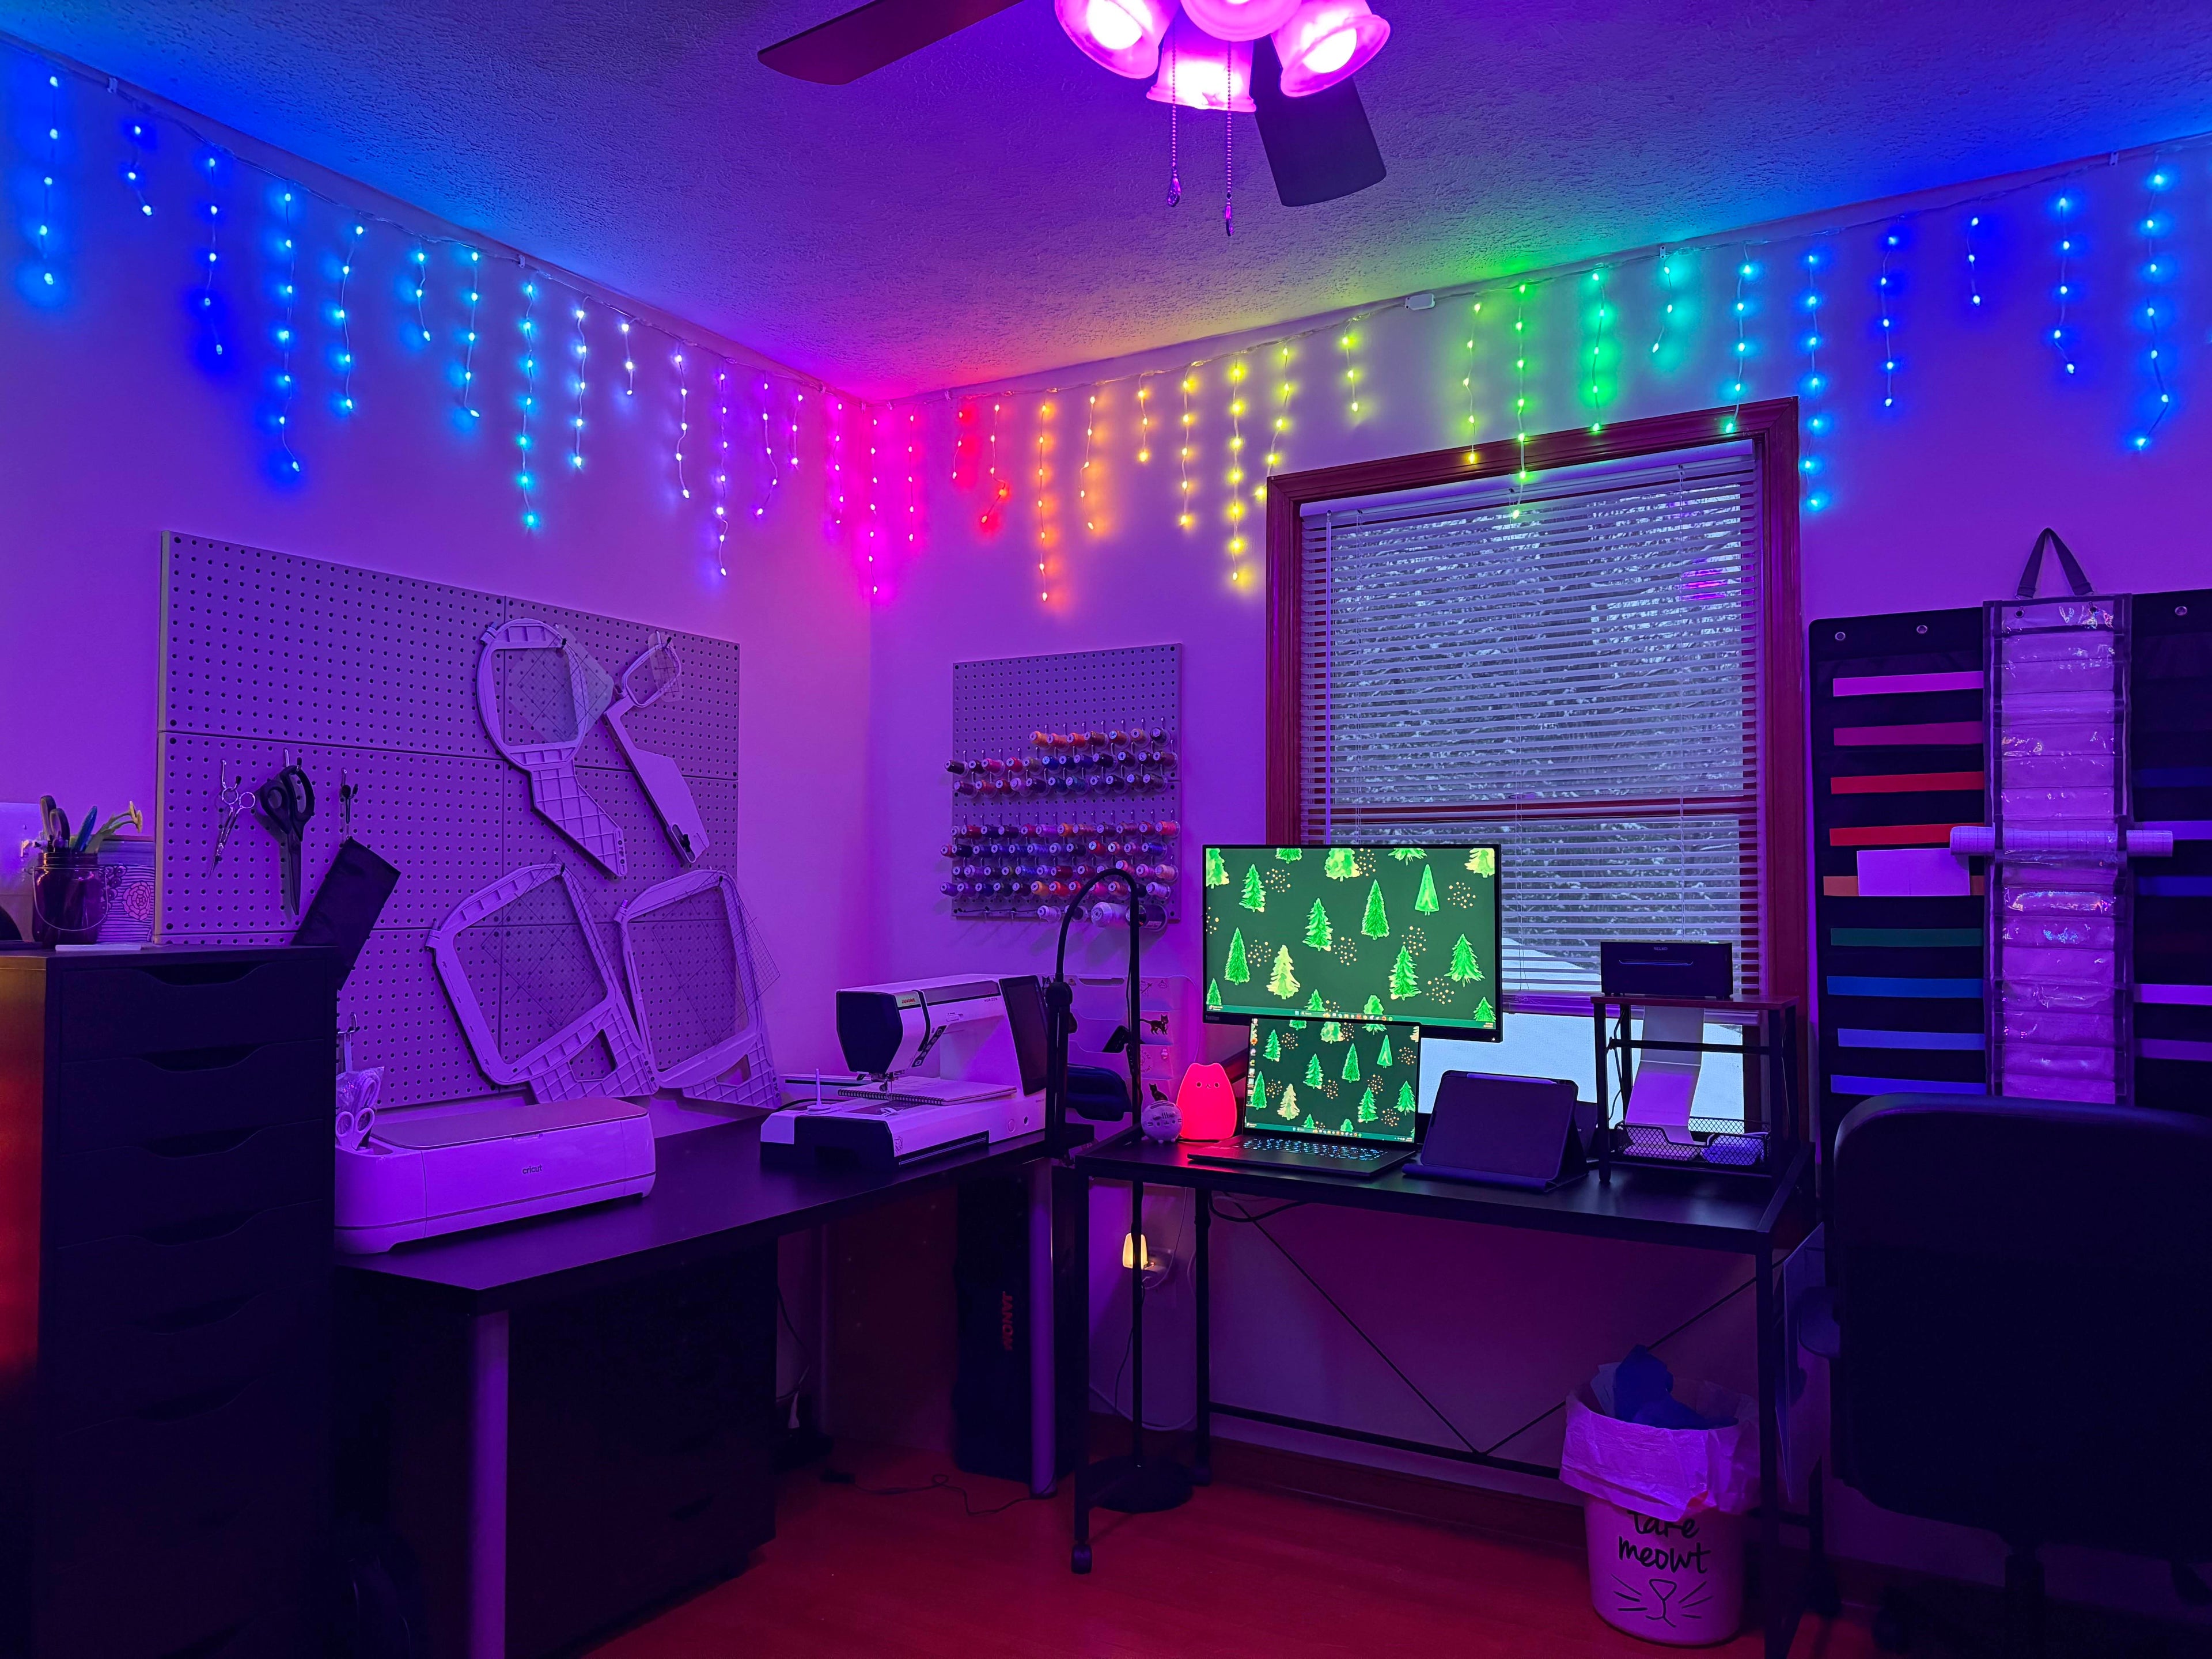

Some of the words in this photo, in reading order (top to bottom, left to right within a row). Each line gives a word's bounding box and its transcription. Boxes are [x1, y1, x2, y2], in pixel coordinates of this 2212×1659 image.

[522, 1164, 543, 1174] cricut
[1002, 1290, 1013, 1352] JANOM
[1619, 1535, 1711, 1574] meowt
